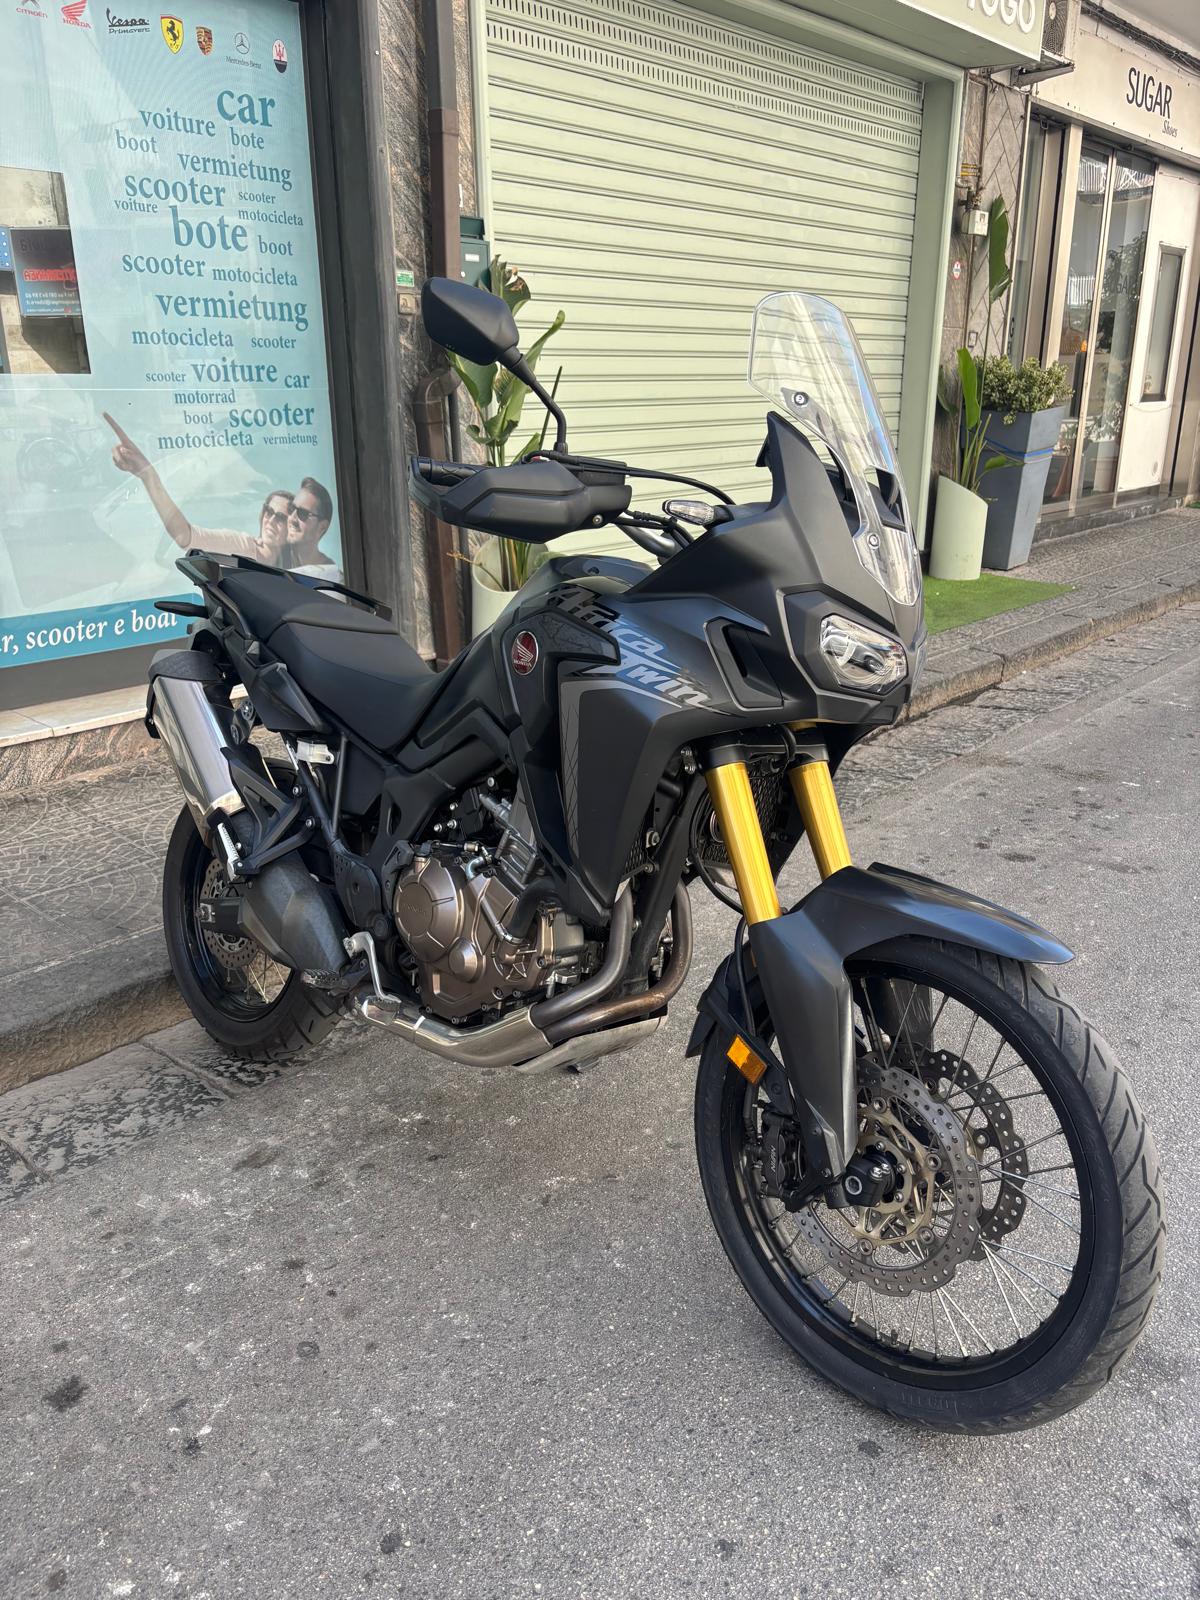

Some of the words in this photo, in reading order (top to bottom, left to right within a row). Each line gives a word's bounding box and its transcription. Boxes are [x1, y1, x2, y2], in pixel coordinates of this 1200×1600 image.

[62, 18, 92, 29] HONDA
[106, 8, 150, 28] Vespa
[1126, 66, 1172, 119] SUGAR
[217, 90, 275, 127] car
[139, 109, 216, 137] voiture
[1162, 120, 1178, 138] Shoes
[115, 130, 157, 153] boot
[230, 127, 264, 150] bote
[177, 151, 292, 191] vermietung
[124, 175, 225, 206] scooter
[238, 191, 276, 204] scooter
[114, 199, 158, 213] voiture
[238, 208, 304, 227] motocicleta
[169, 205, 248, 252] bote
[258, 236, 293, 256] boot
[122, 254, 205, 277] scooter
[213, 266, 297, 286] motocicleta
[156, 291, 308, 331] vermietung
[132, 329, 233, 347] motocicleta
[251, 336, 296, 349] scooter
[146, 371, 185, 382] scooter
[190, 357, 278, 383] voiture
[284, 373, 310, 388] car
[174, 389, 236, 404] motorrad
[184, 410, 213, 425] boot
[229, 402, 315, 427] scooter
[158, 429, 254, 450] motocicleta
[263, 433, 318, 447] vermietung
[0, 634, 19, 655] r,
[25, 620, 108, 650] scooter
[114, 619, 125, 635] e
[513, 659, 533, 668] HONDA
